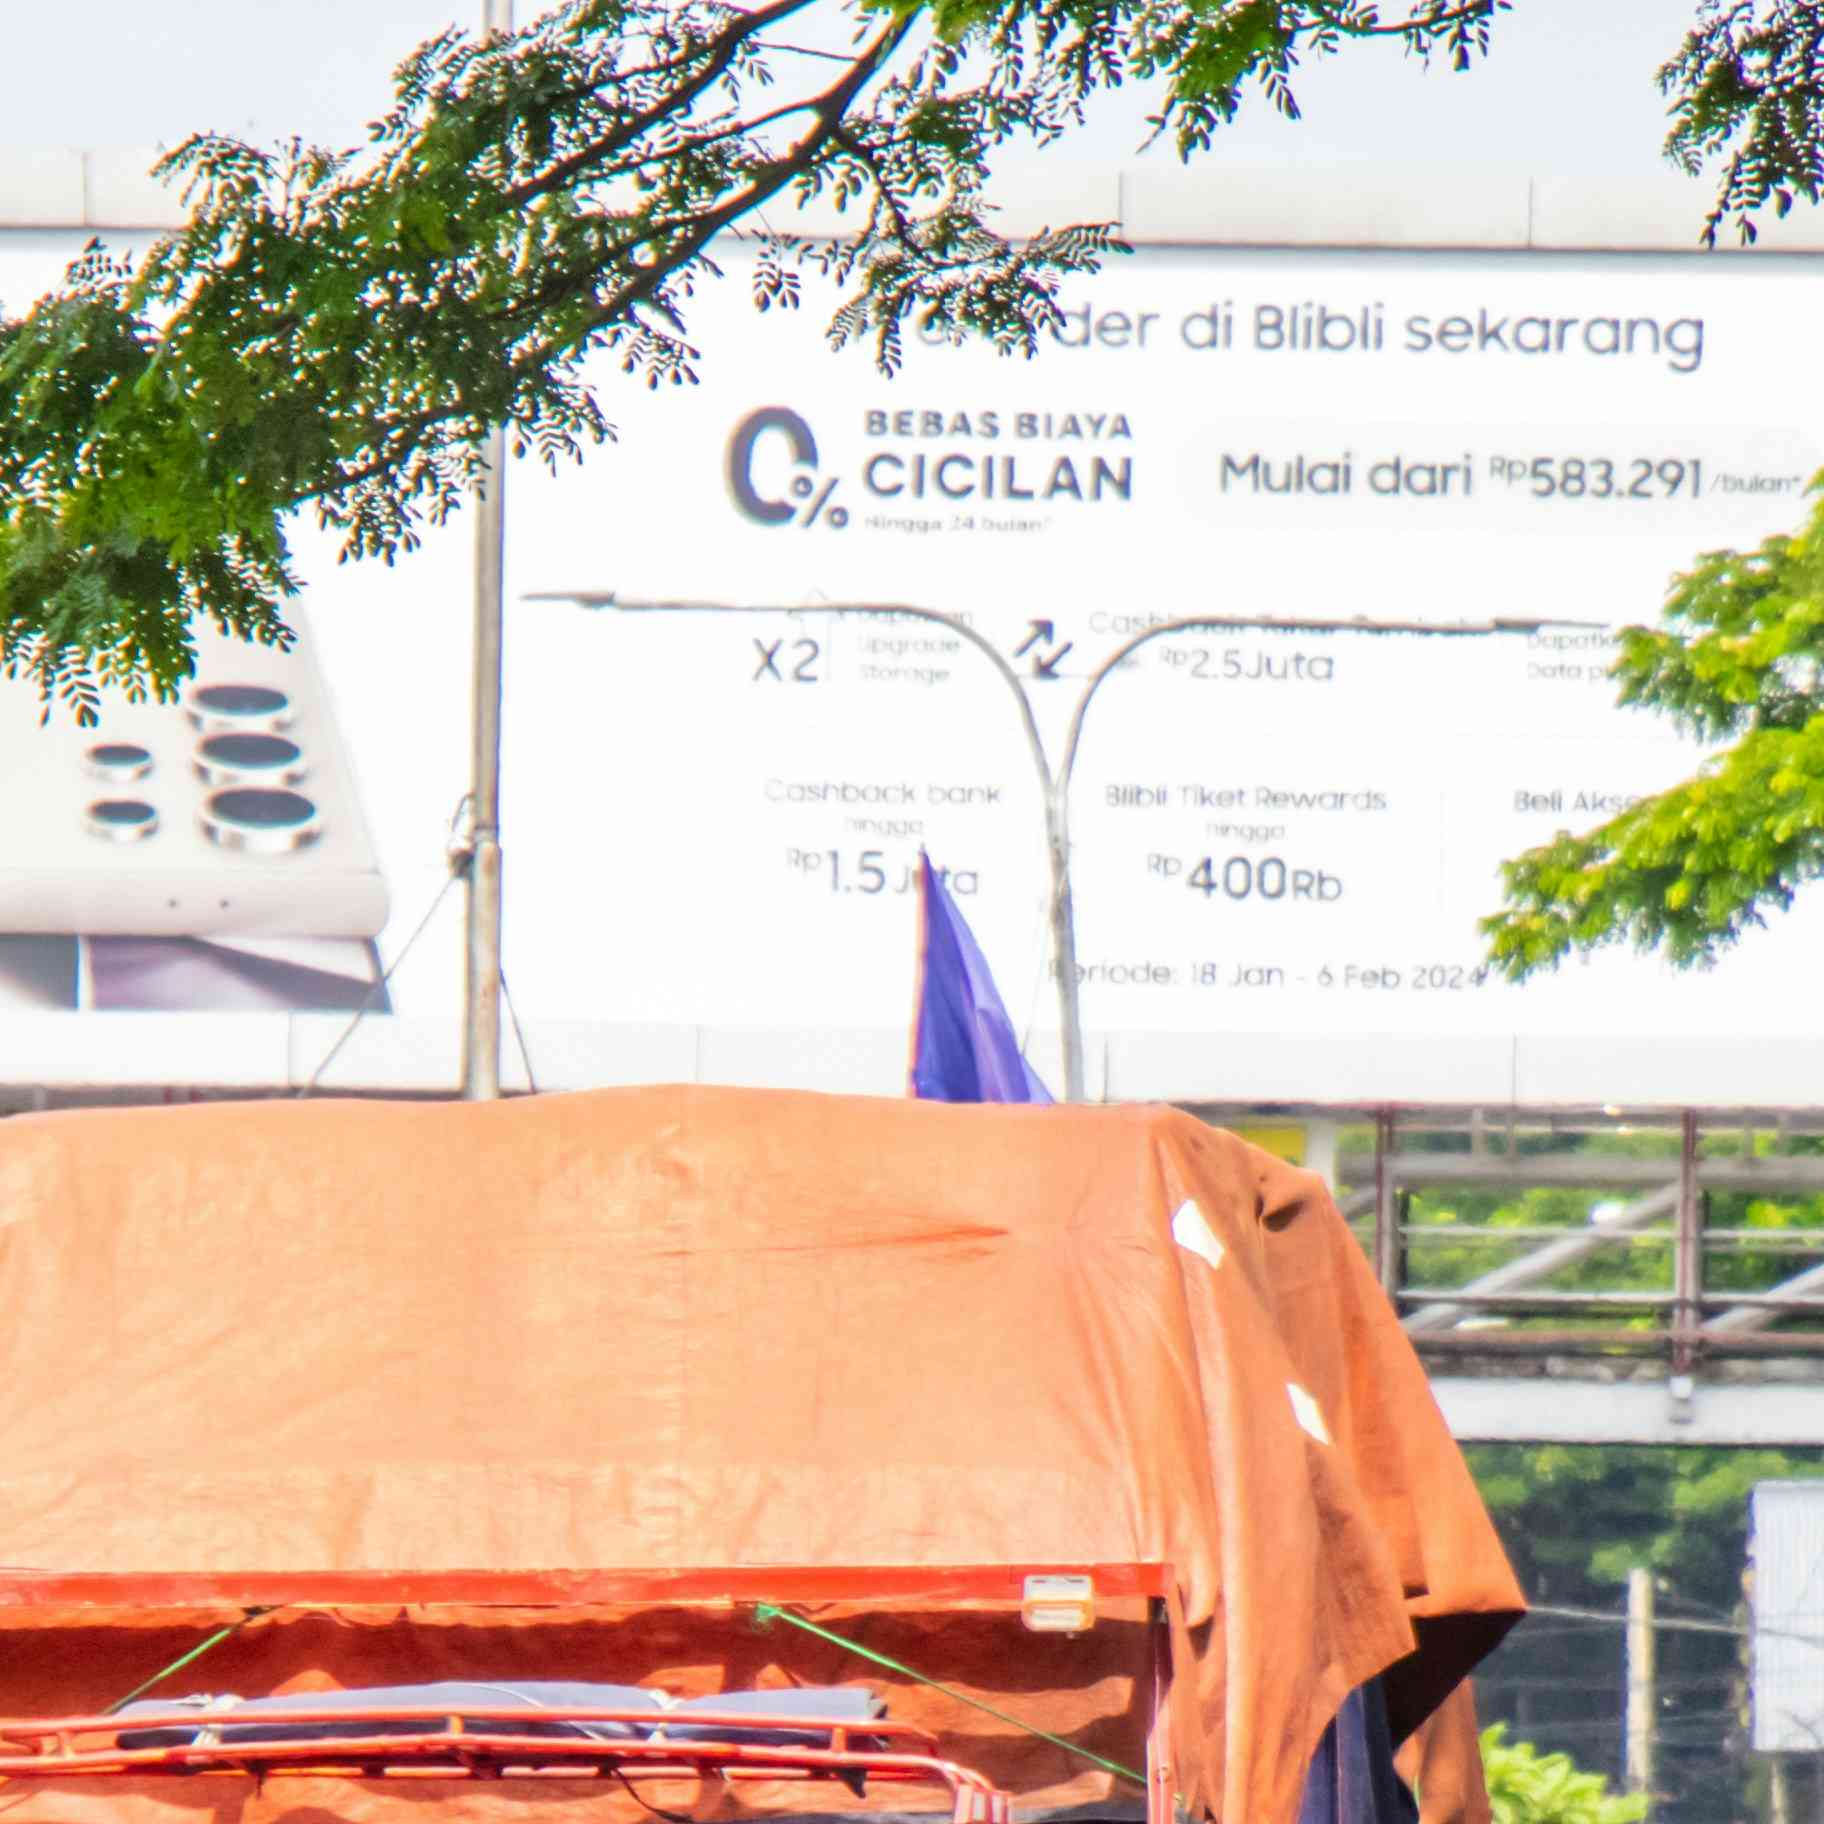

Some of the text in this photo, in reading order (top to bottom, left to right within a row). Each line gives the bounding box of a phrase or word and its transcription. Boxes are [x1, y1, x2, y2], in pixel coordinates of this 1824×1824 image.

[1181, 301, 1233, 350] di
[1255, 304, 1384, 352] Blibli
[1405, 308, 1705, 374] sekarang
[865, 410, 1132, 440] BEBAS BIAYA
[863, 453, 1133, 501] CICILAN
[1220, 452, 1352, 495] Mulai
[1368, 453, 1472, 496] dari
[752, 637, 821, 682] X2
[764, 779, 1002, 806] Cashback bank
[1179, 783, 1248, 809] Tiket
[1254, 785, 1388, 812] Rewards
[1228, 962, 1286, 988] Jan
[1316, 962, 1336, 988] 6
[1343, 962, 1403, 990] Feb
